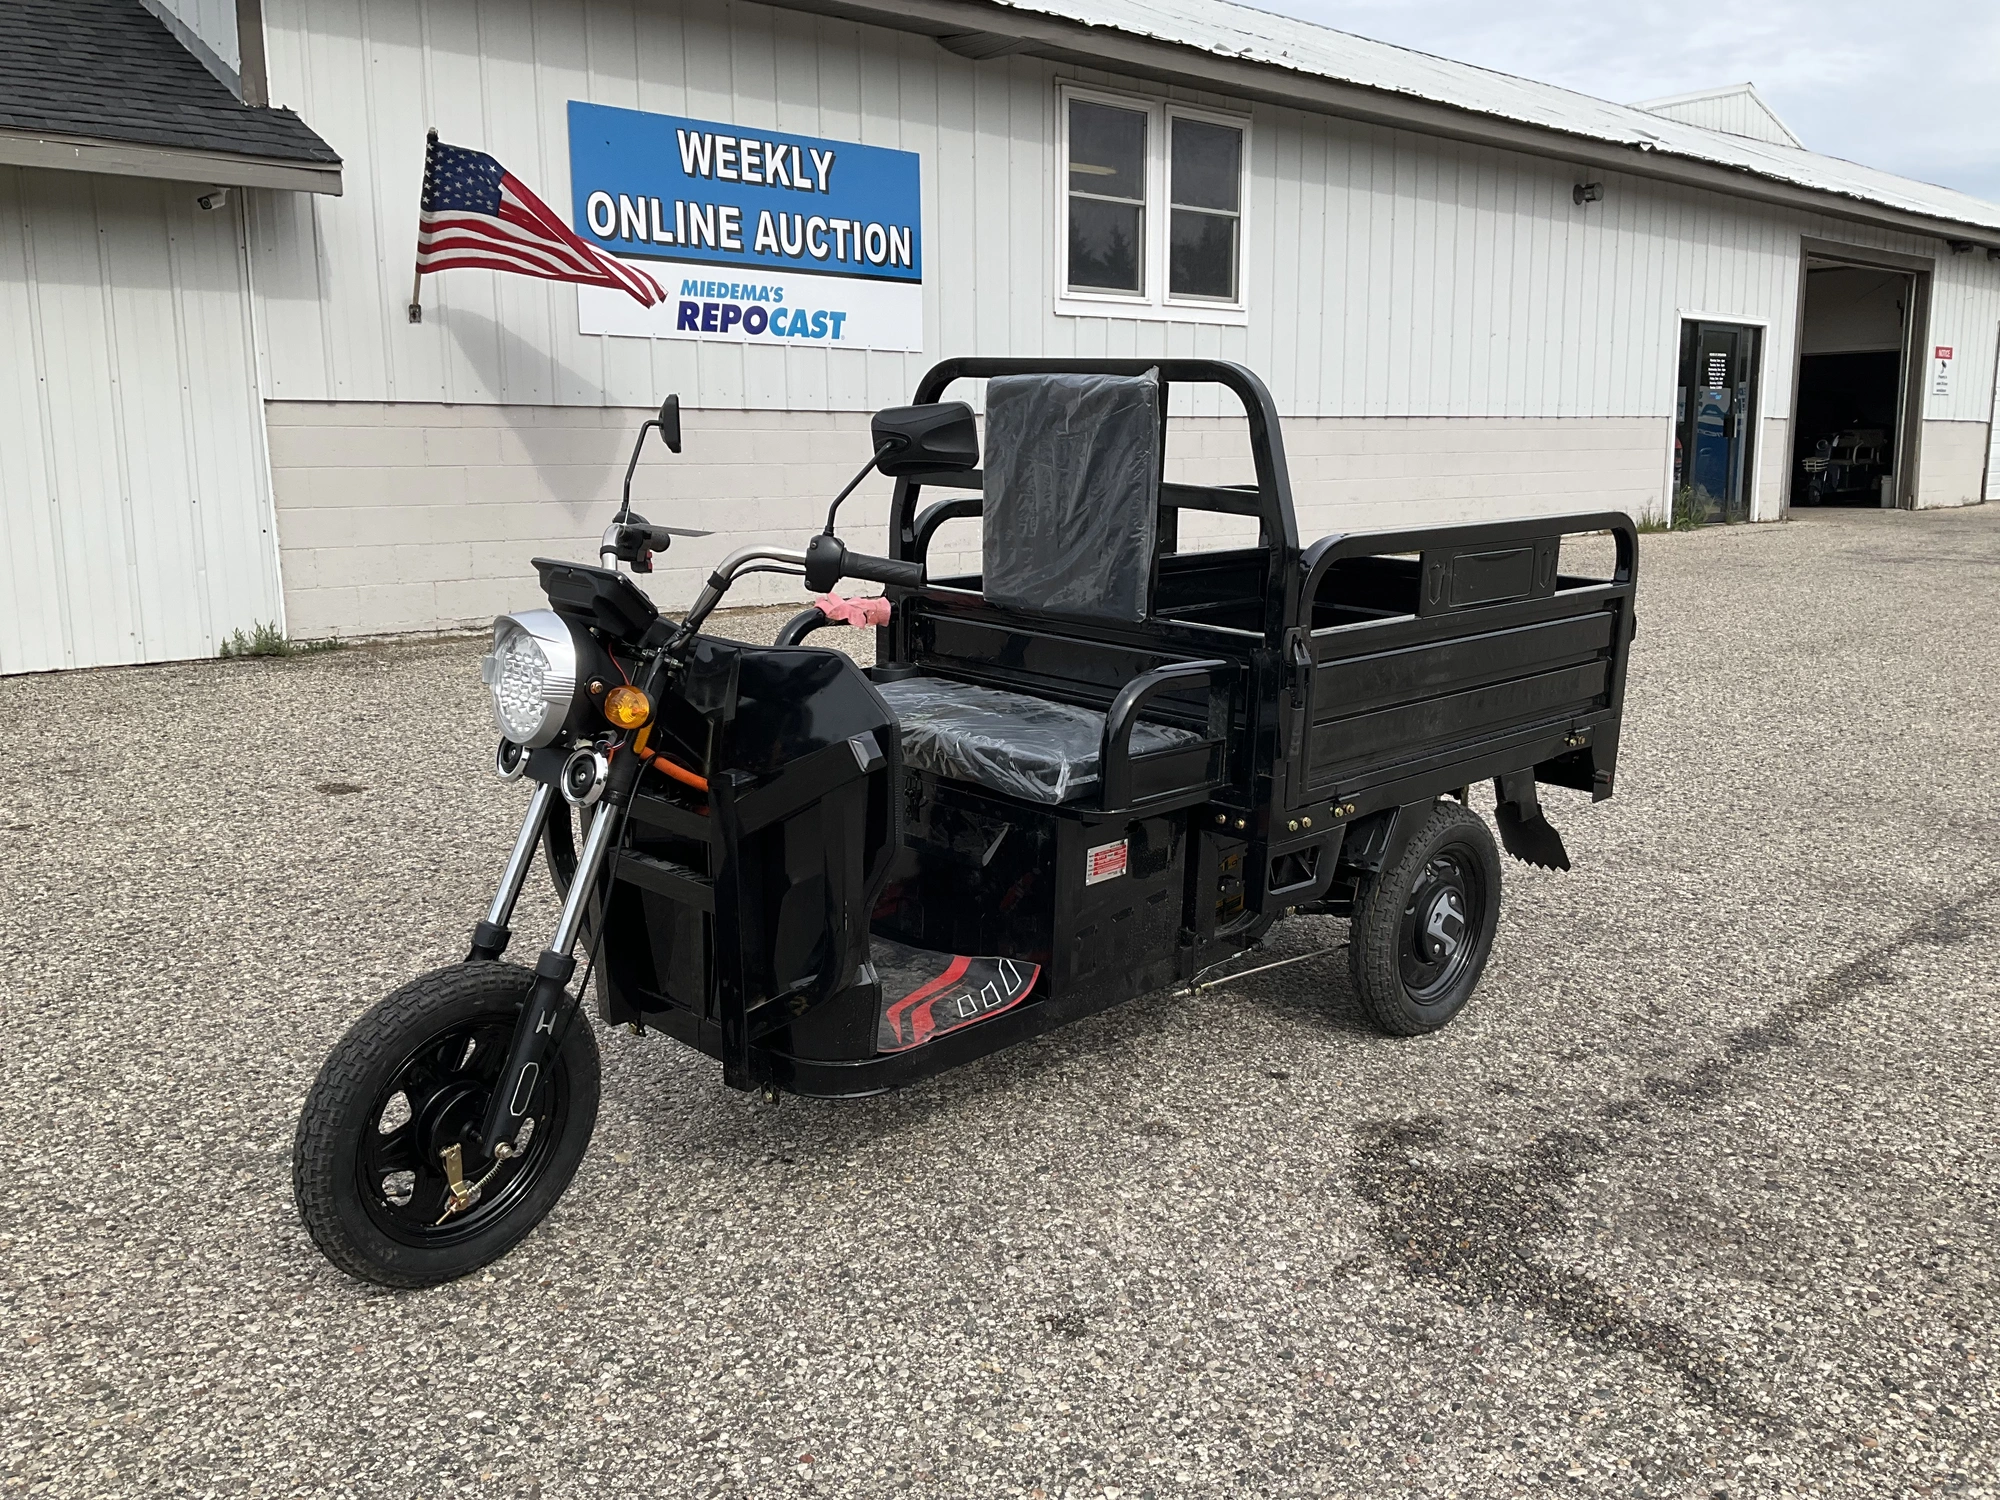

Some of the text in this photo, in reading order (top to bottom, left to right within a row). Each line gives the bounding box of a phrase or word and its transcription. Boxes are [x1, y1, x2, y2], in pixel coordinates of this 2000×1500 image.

[676, 128, 835, 193] WEEKLY
[586, 190, 913, 269] ONLINE AUCTION
[680, 279, 784, 303] MIEDEMA'S
[676, 300, 847, 340] REPOCAST
